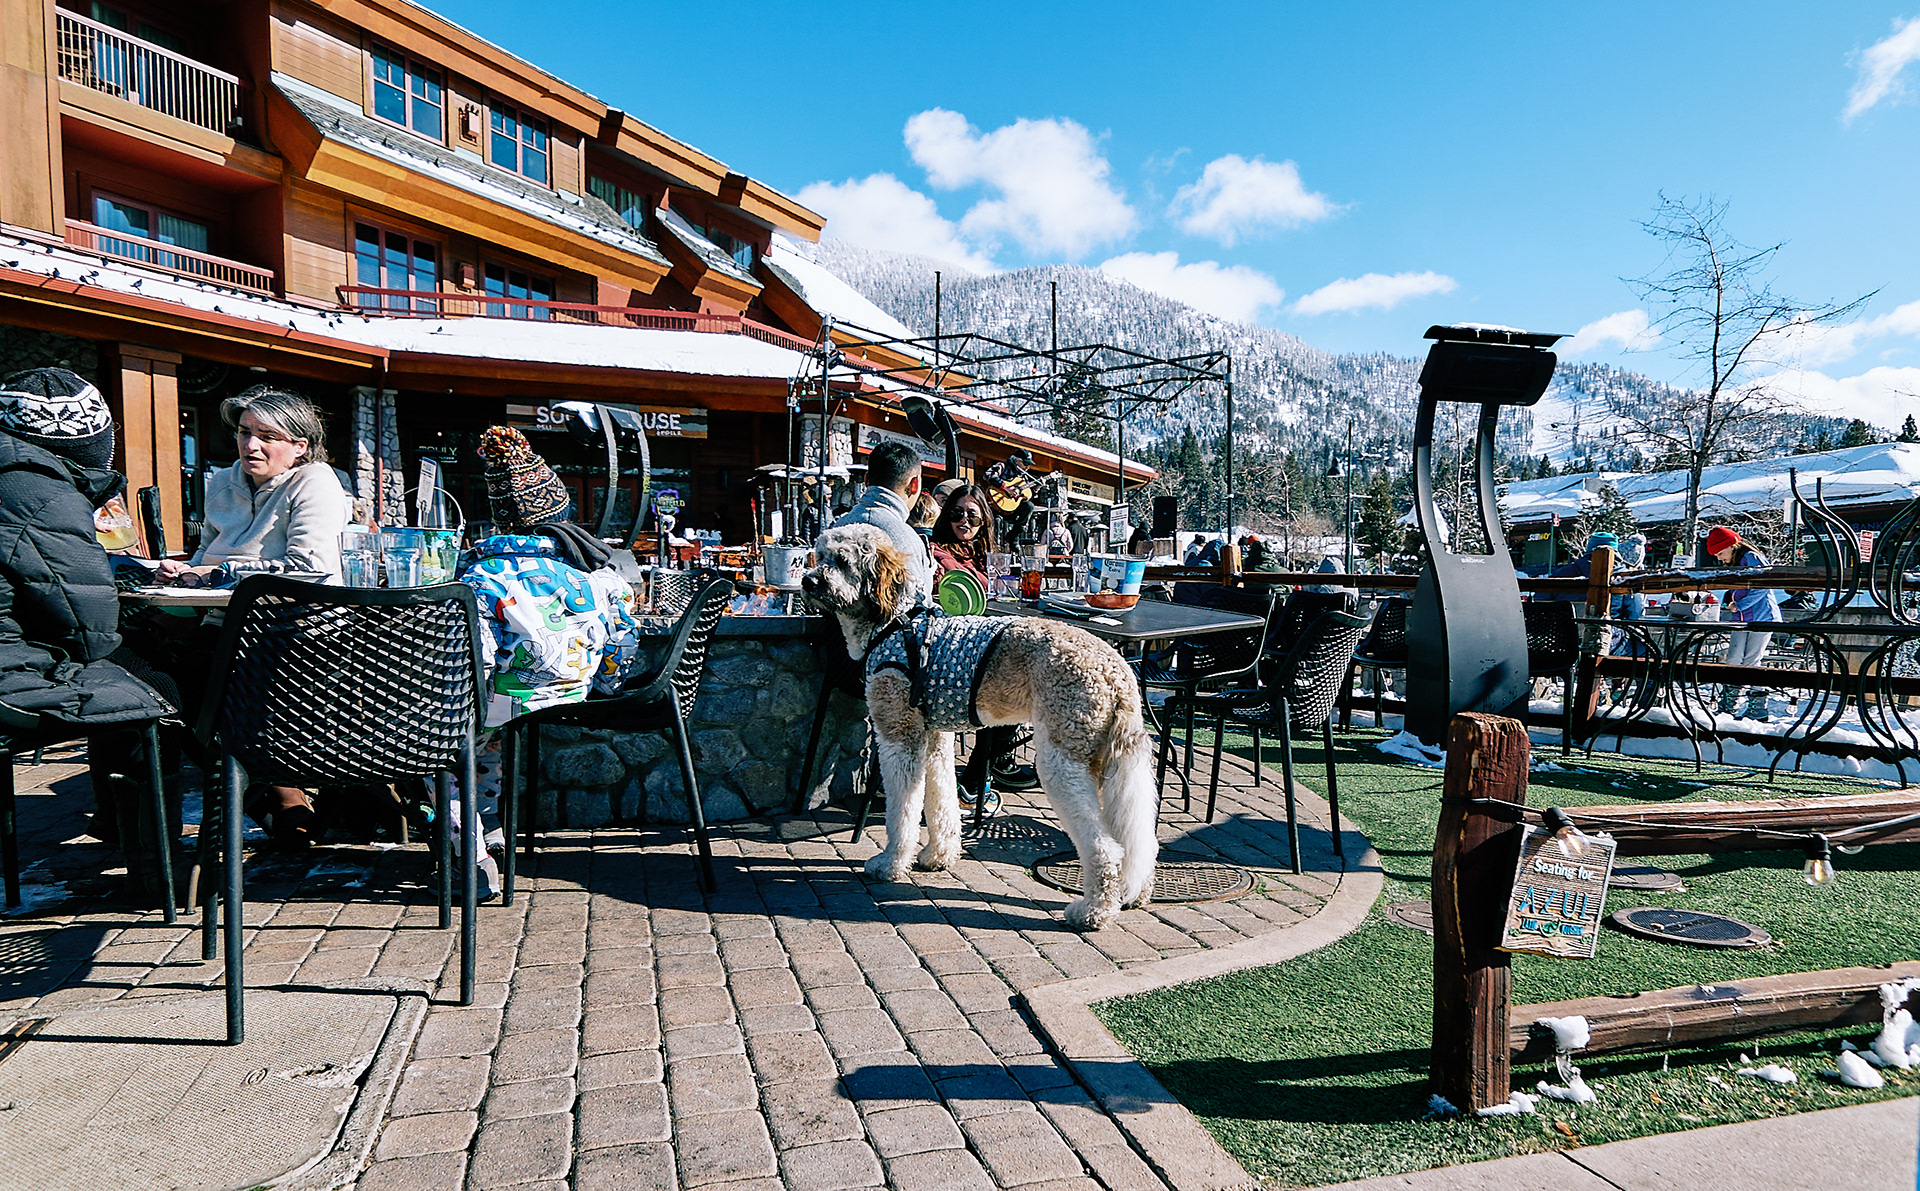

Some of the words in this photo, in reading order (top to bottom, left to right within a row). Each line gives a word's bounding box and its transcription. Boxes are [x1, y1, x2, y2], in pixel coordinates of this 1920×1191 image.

[1534, 859, 1574, 880] Seating
[1578, 865, 1592, 881] for
[1517, 886, 1593, 921] AZUL
